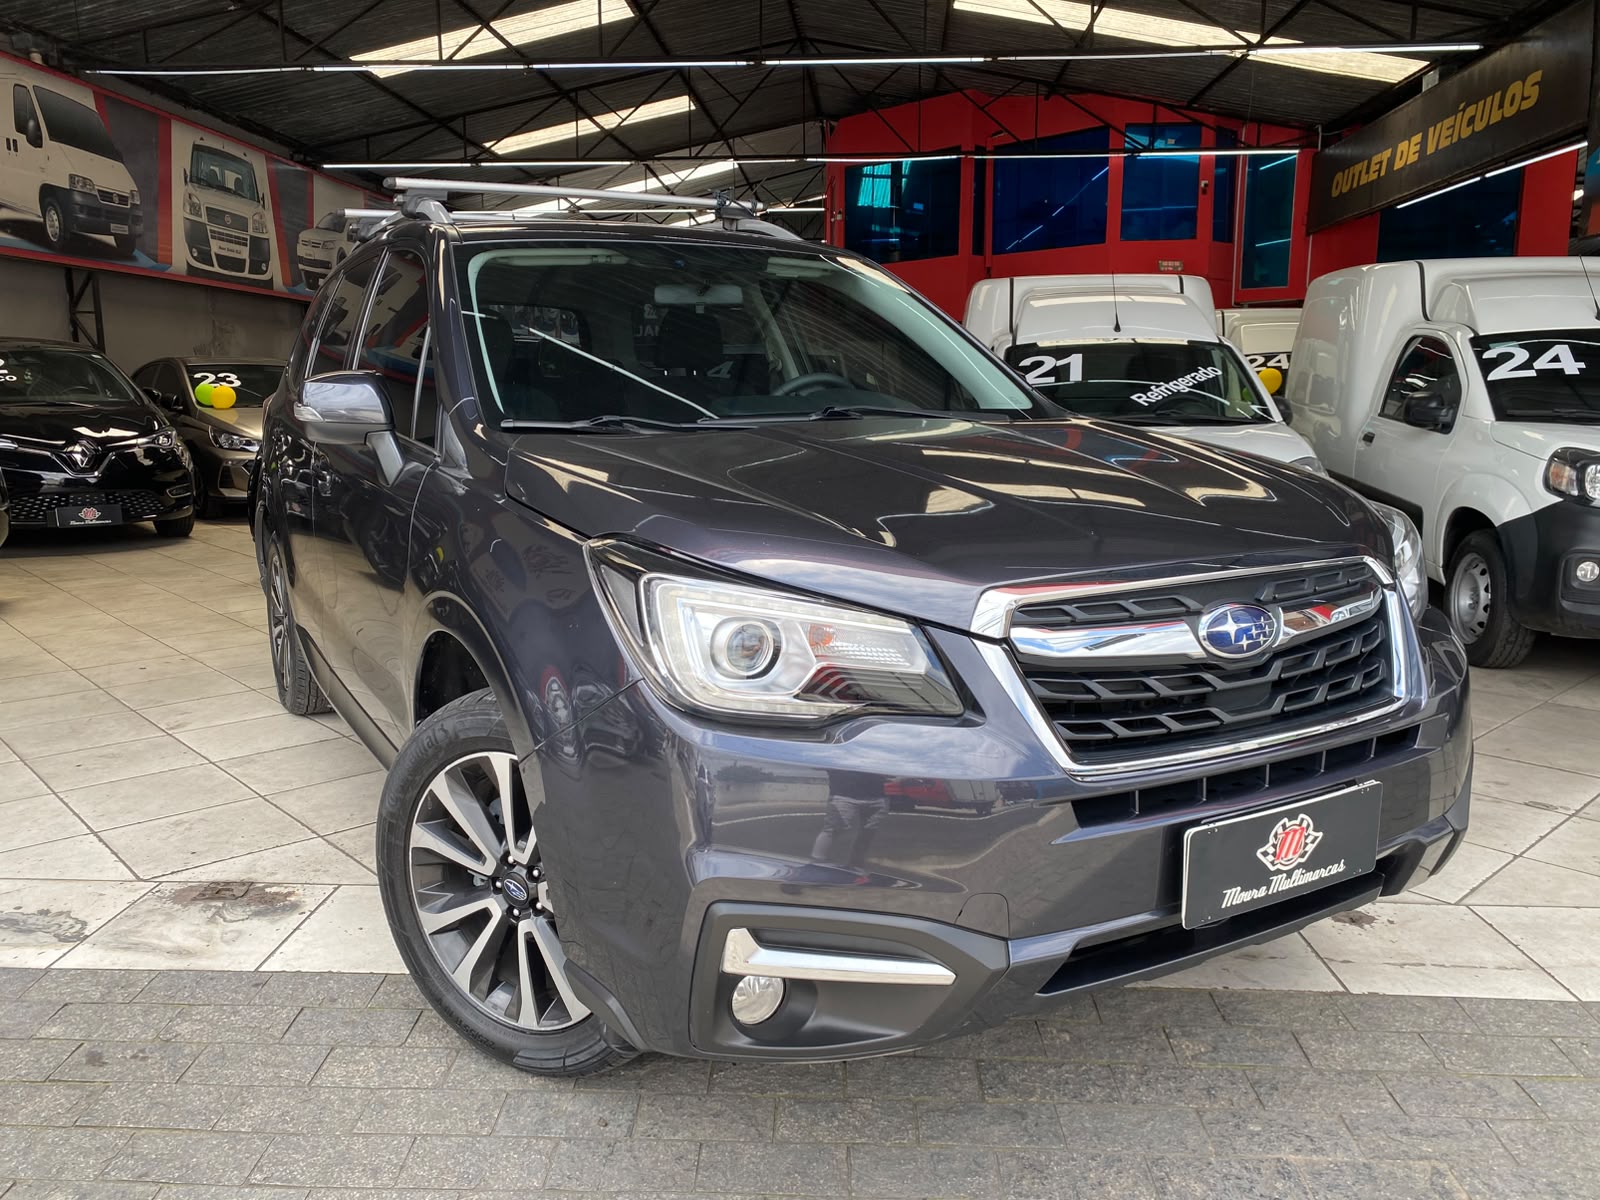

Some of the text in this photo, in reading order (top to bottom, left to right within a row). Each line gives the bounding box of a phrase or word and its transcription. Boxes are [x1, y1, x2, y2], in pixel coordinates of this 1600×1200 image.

[1331, 70, 1543, 198] OUTLET DE VEÍCULOS
[193, 372, 242, 388] 23
[1018, 353, 1083, 386] 21
[1246, 353, 1290, 372] 24
[1481, 344, 1587, 381] 24
[1129, 365, 1223, 407] Refrigerado
[1220, 858, 1346, 909] Moura Multimarcas
